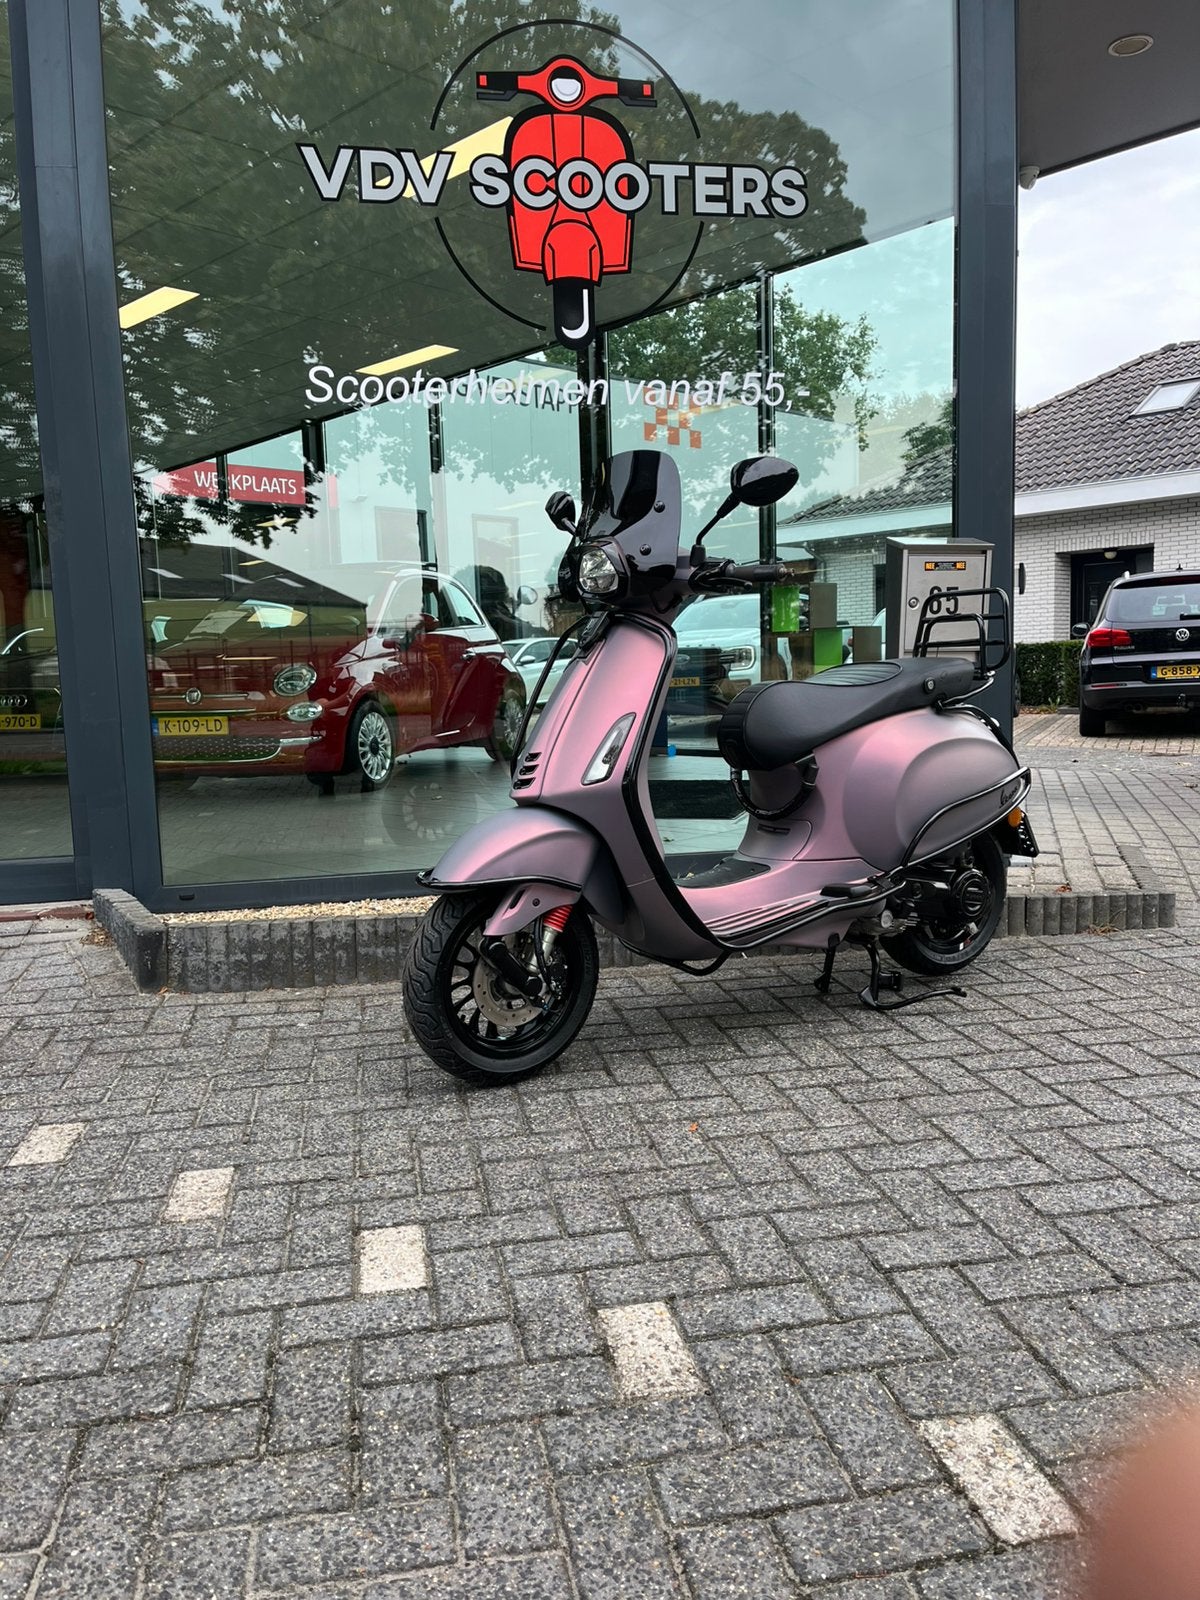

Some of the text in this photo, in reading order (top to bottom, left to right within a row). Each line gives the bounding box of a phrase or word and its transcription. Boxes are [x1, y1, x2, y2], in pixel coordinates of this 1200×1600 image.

[297, 143, 808, 219] VDV SCOOTERS
[305, 365, 609, 406] Scooterhelmen
[624, 371, 731, 406] vanaf
[194, 471, 297, 495] WEKPLAATS
[0, 716, 37, 728] -970-D
[164, 719, 223, 733] K-109-LD
